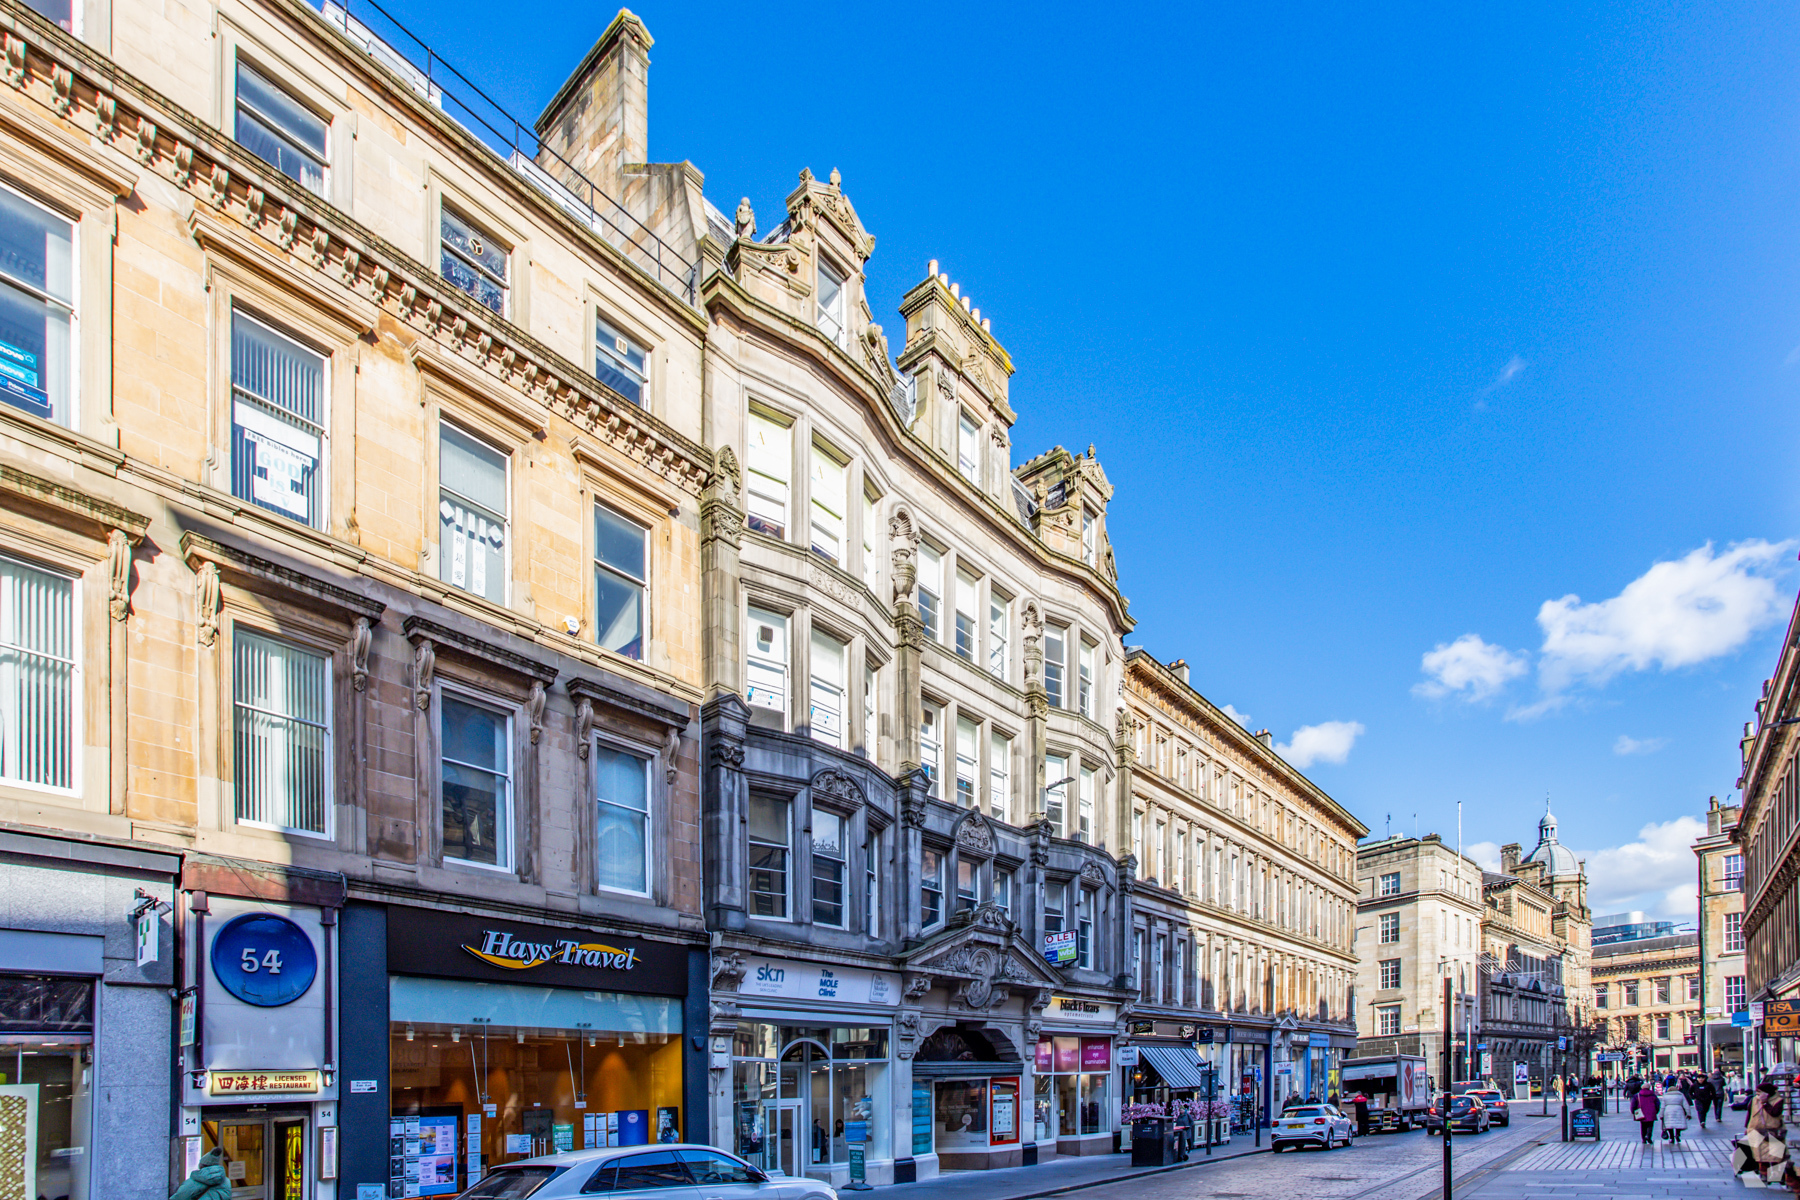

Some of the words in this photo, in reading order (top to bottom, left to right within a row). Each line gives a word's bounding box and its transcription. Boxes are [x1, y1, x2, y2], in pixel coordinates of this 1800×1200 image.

[259, 451, 301, 480] GOD
[1046, 935, 1054, 944] O
[1057, 931, 1073, 941] LET
[483, 930, 552, 966] Hays
[555, 939, 635, 970] Travel
[241, 948, 283, 974] 54
[821, 969, 834, 978] The
[820, 978, 838, 988] MOLE
[819, 988, 836, 997] Clinic
[1060, 1000, 1077, 1010] black
[1767, 1002, 1793, 1013] HSA
[1766, 1016, 1790, 1026] TO
[218, 1074, 268, 1091] 四海樓
